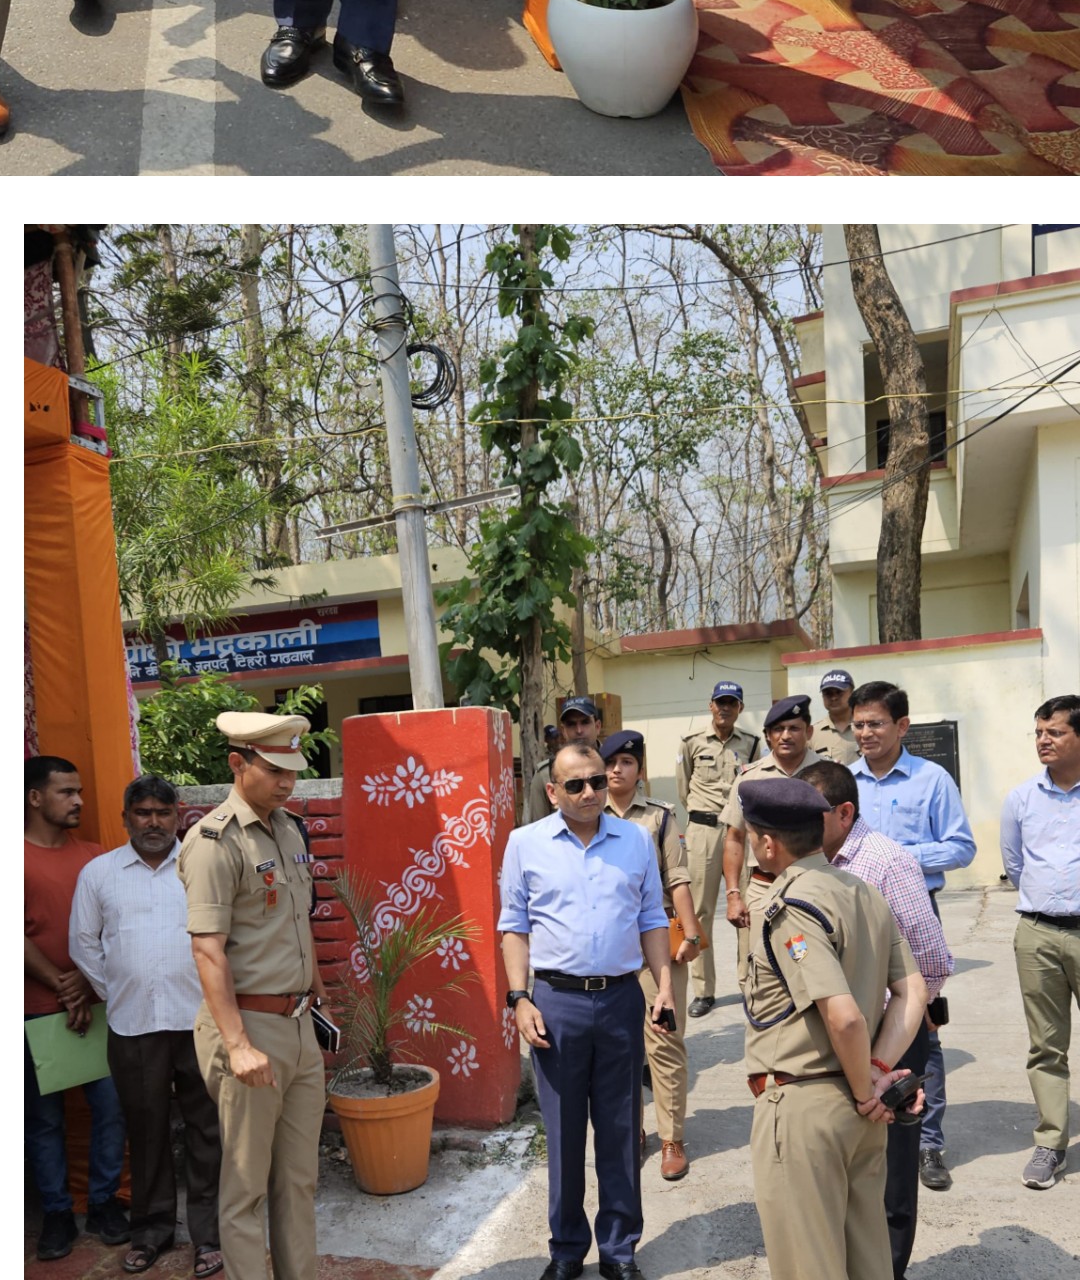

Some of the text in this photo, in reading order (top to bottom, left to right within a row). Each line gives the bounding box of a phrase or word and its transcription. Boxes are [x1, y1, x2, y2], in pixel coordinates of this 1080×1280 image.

[191, 618, 322, 659] भद्रकाली
[234, 651, 267, 669] टिहरी
[823, 674, 846, 684] POLICE
